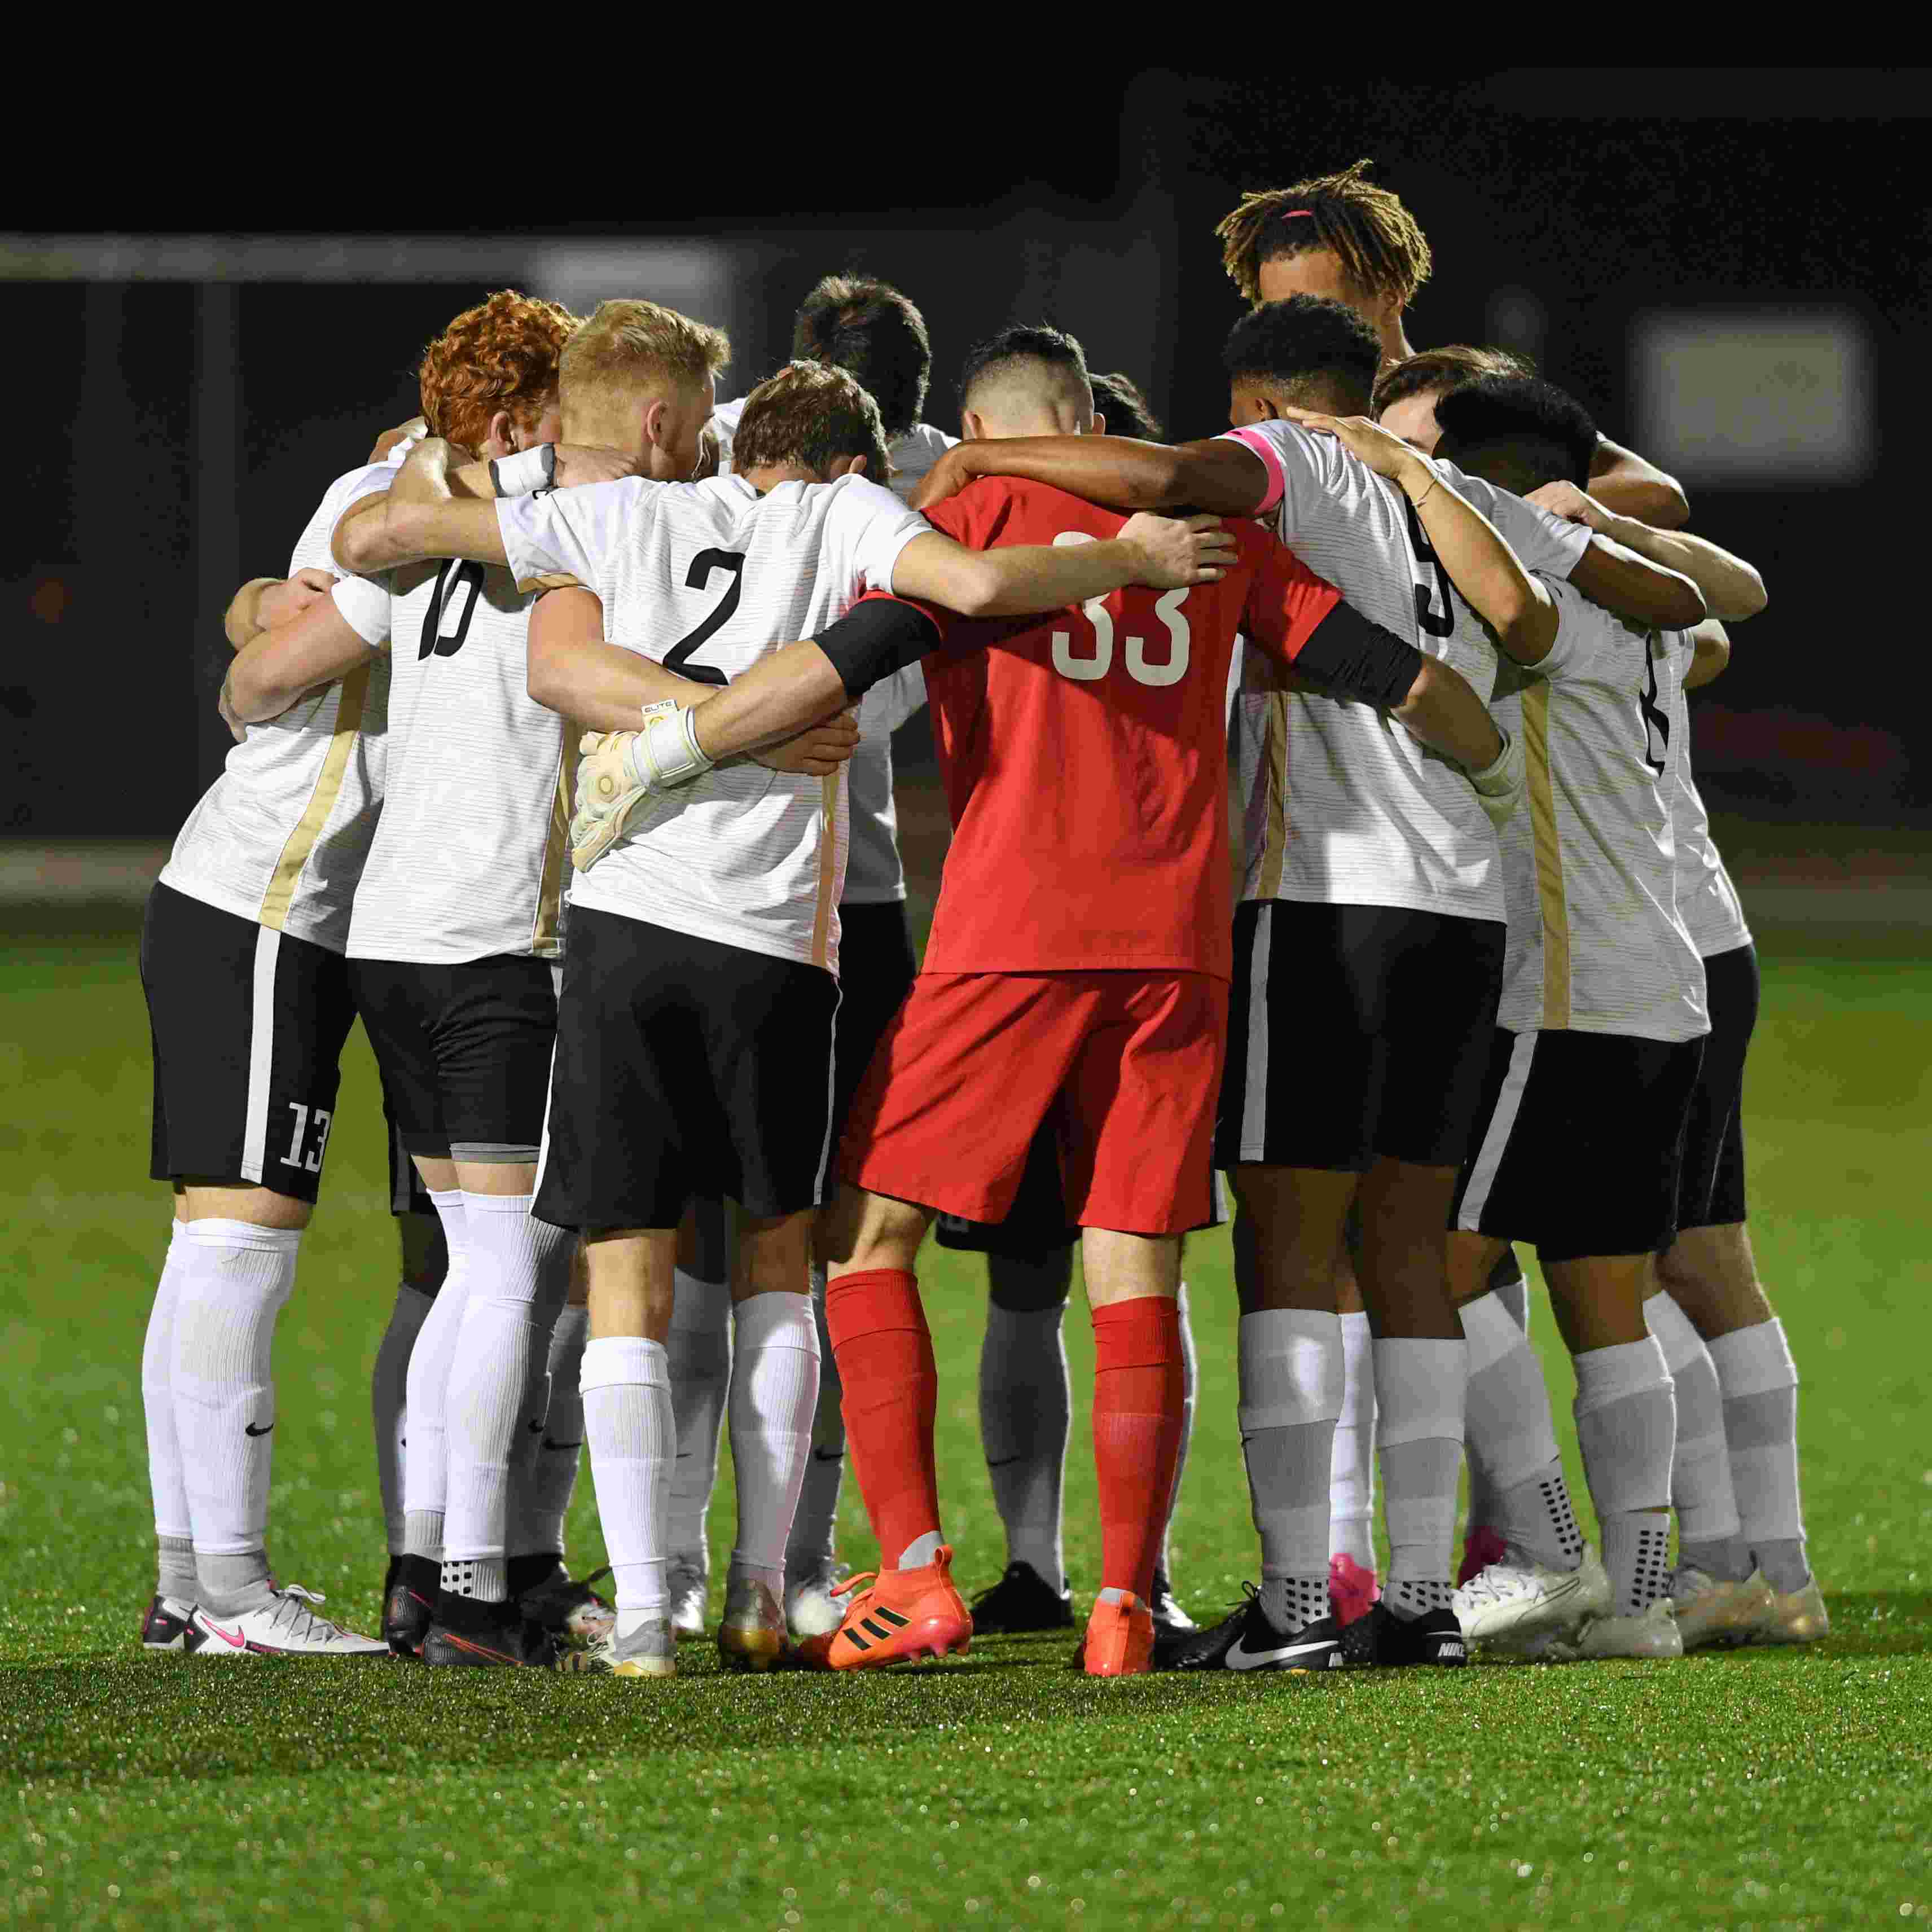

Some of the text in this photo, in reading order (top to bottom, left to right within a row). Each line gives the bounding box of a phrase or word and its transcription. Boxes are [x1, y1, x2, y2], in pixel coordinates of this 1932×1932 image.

[662, 547, 746, 685] 2
[1052, 531, 1190, 685] 33
[644, 701, 673, 713] ELITE
[280, 1102, 331, 1173] 13
[1438, 1643, 1466, 1657] NIKE
